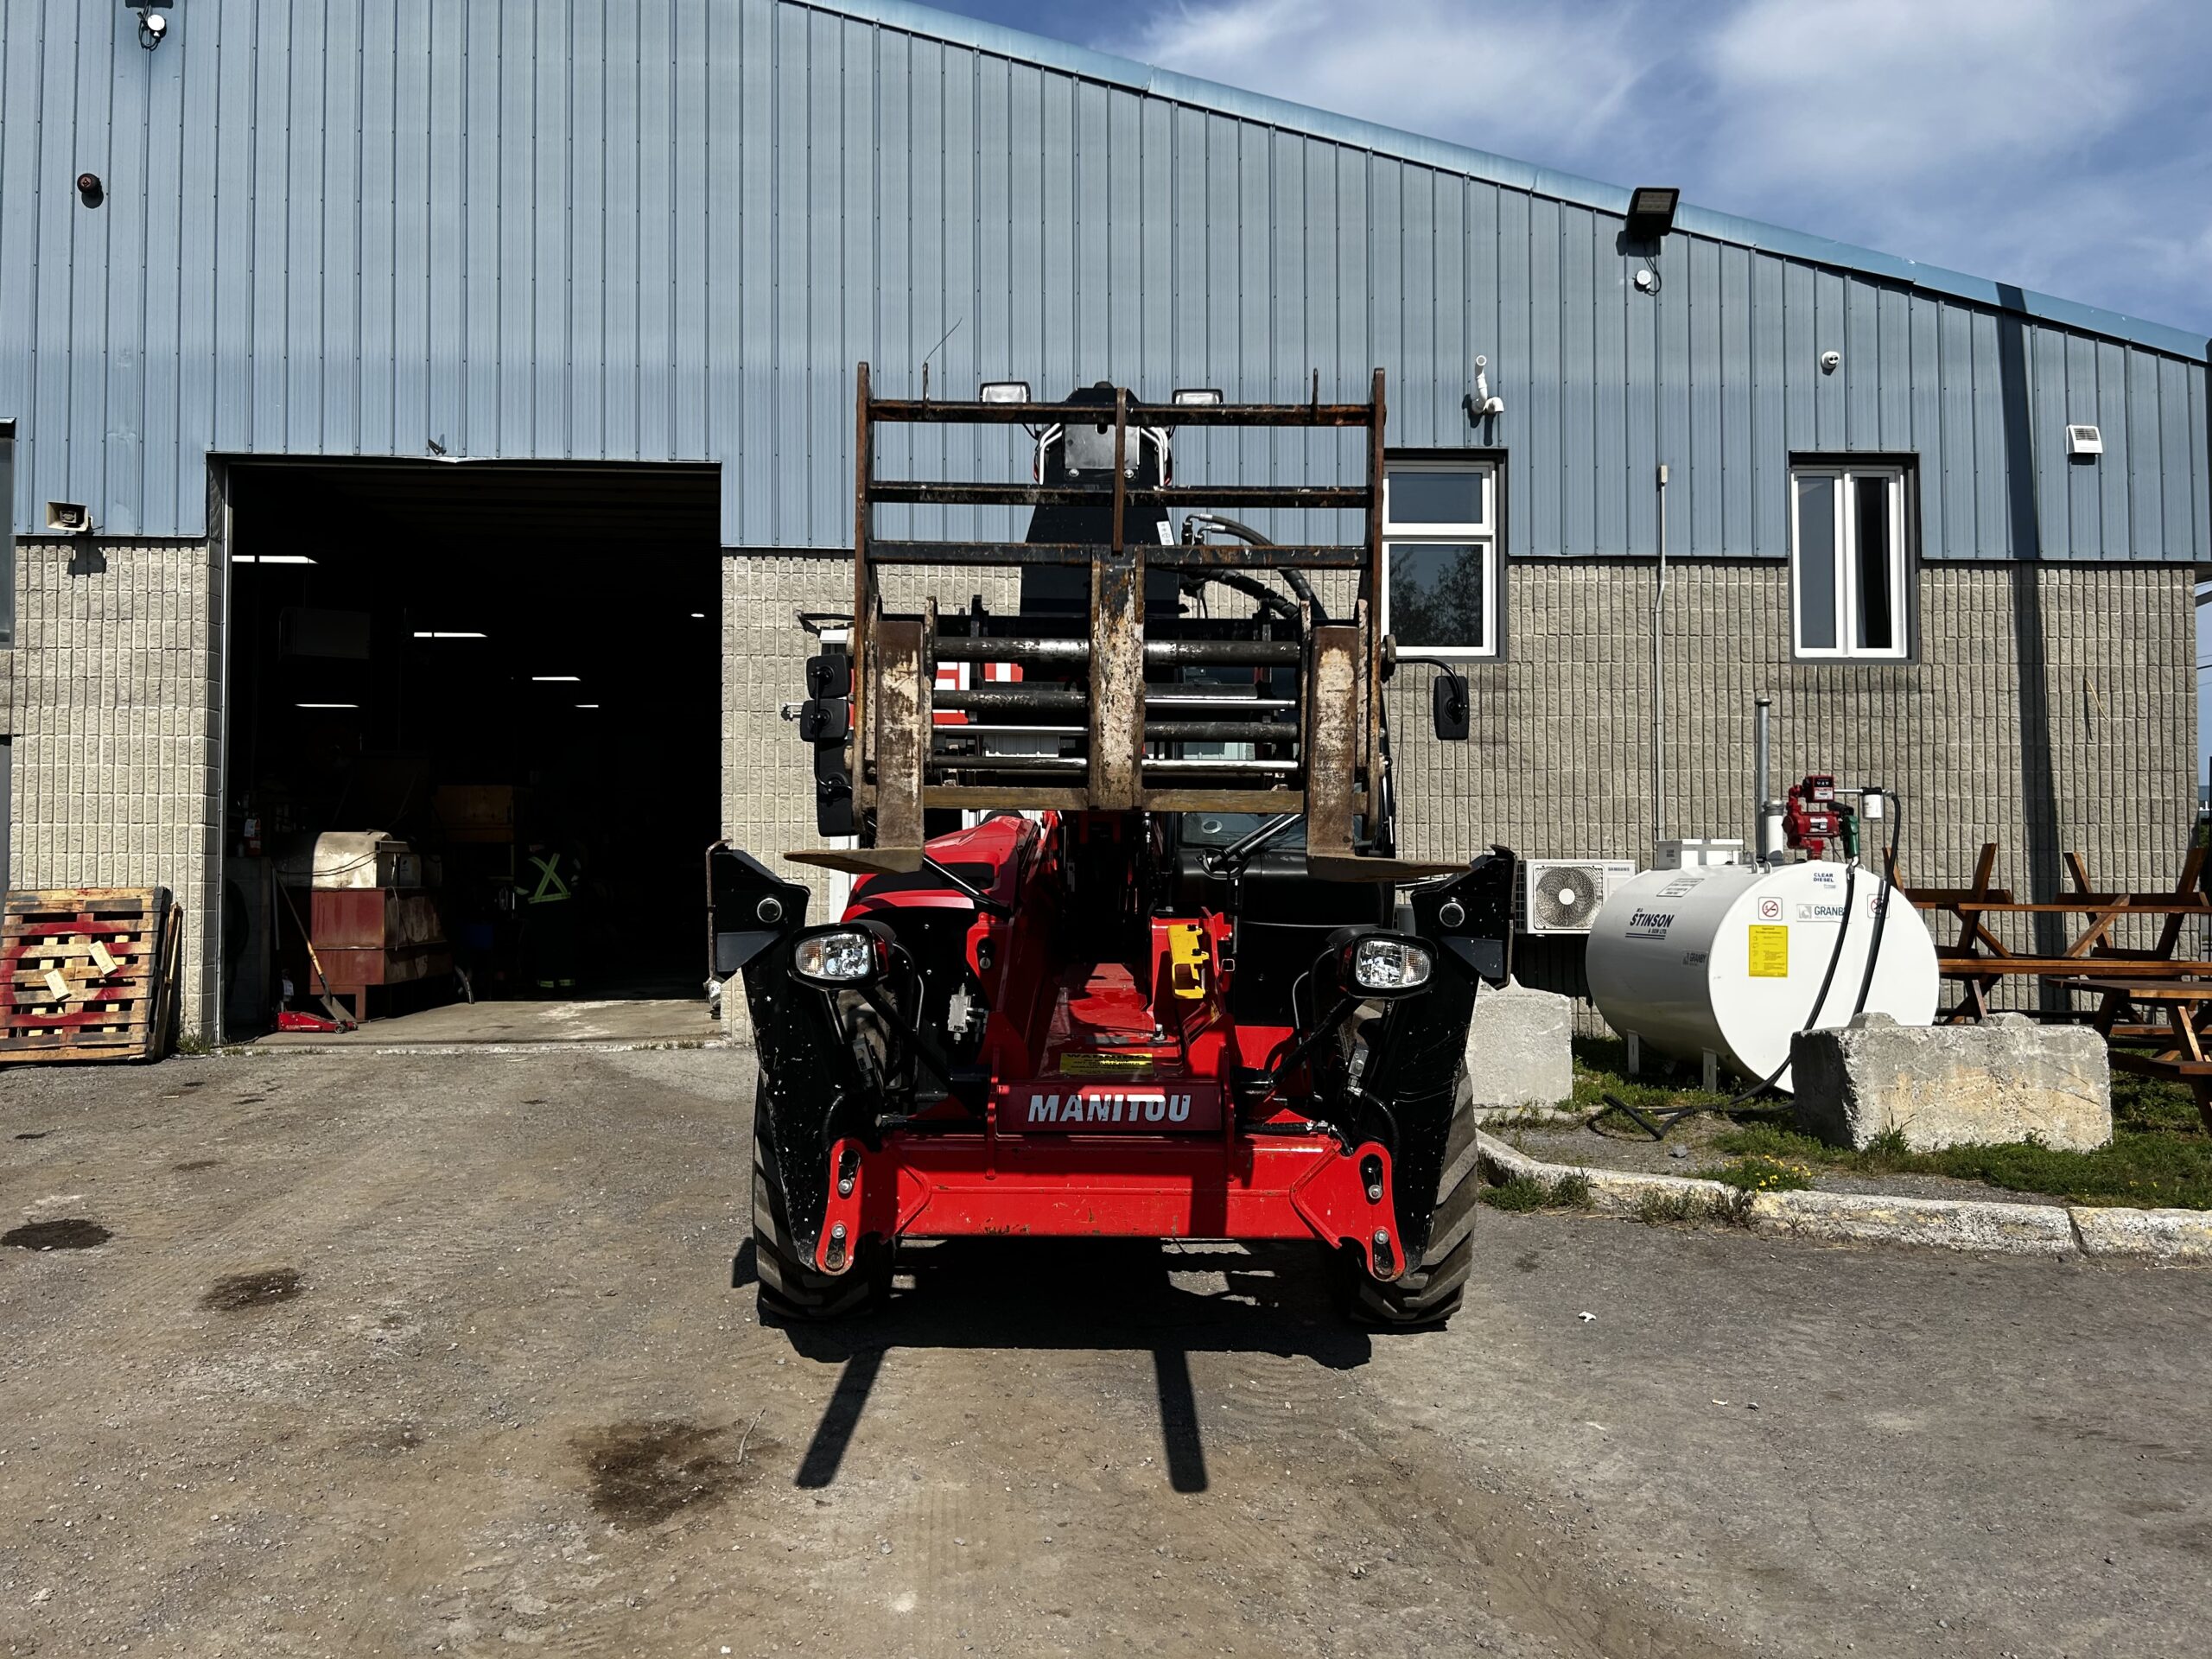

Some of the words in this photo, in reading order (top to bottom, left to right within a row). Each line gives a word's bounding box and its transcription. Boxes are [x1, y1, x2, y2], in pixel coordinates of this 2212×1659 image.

[1814, 906, 1846, 917] GRANB
[1630, 913, 1675, 928] STINSON
[1027, 1094, 1192, 1122] MANITOU
